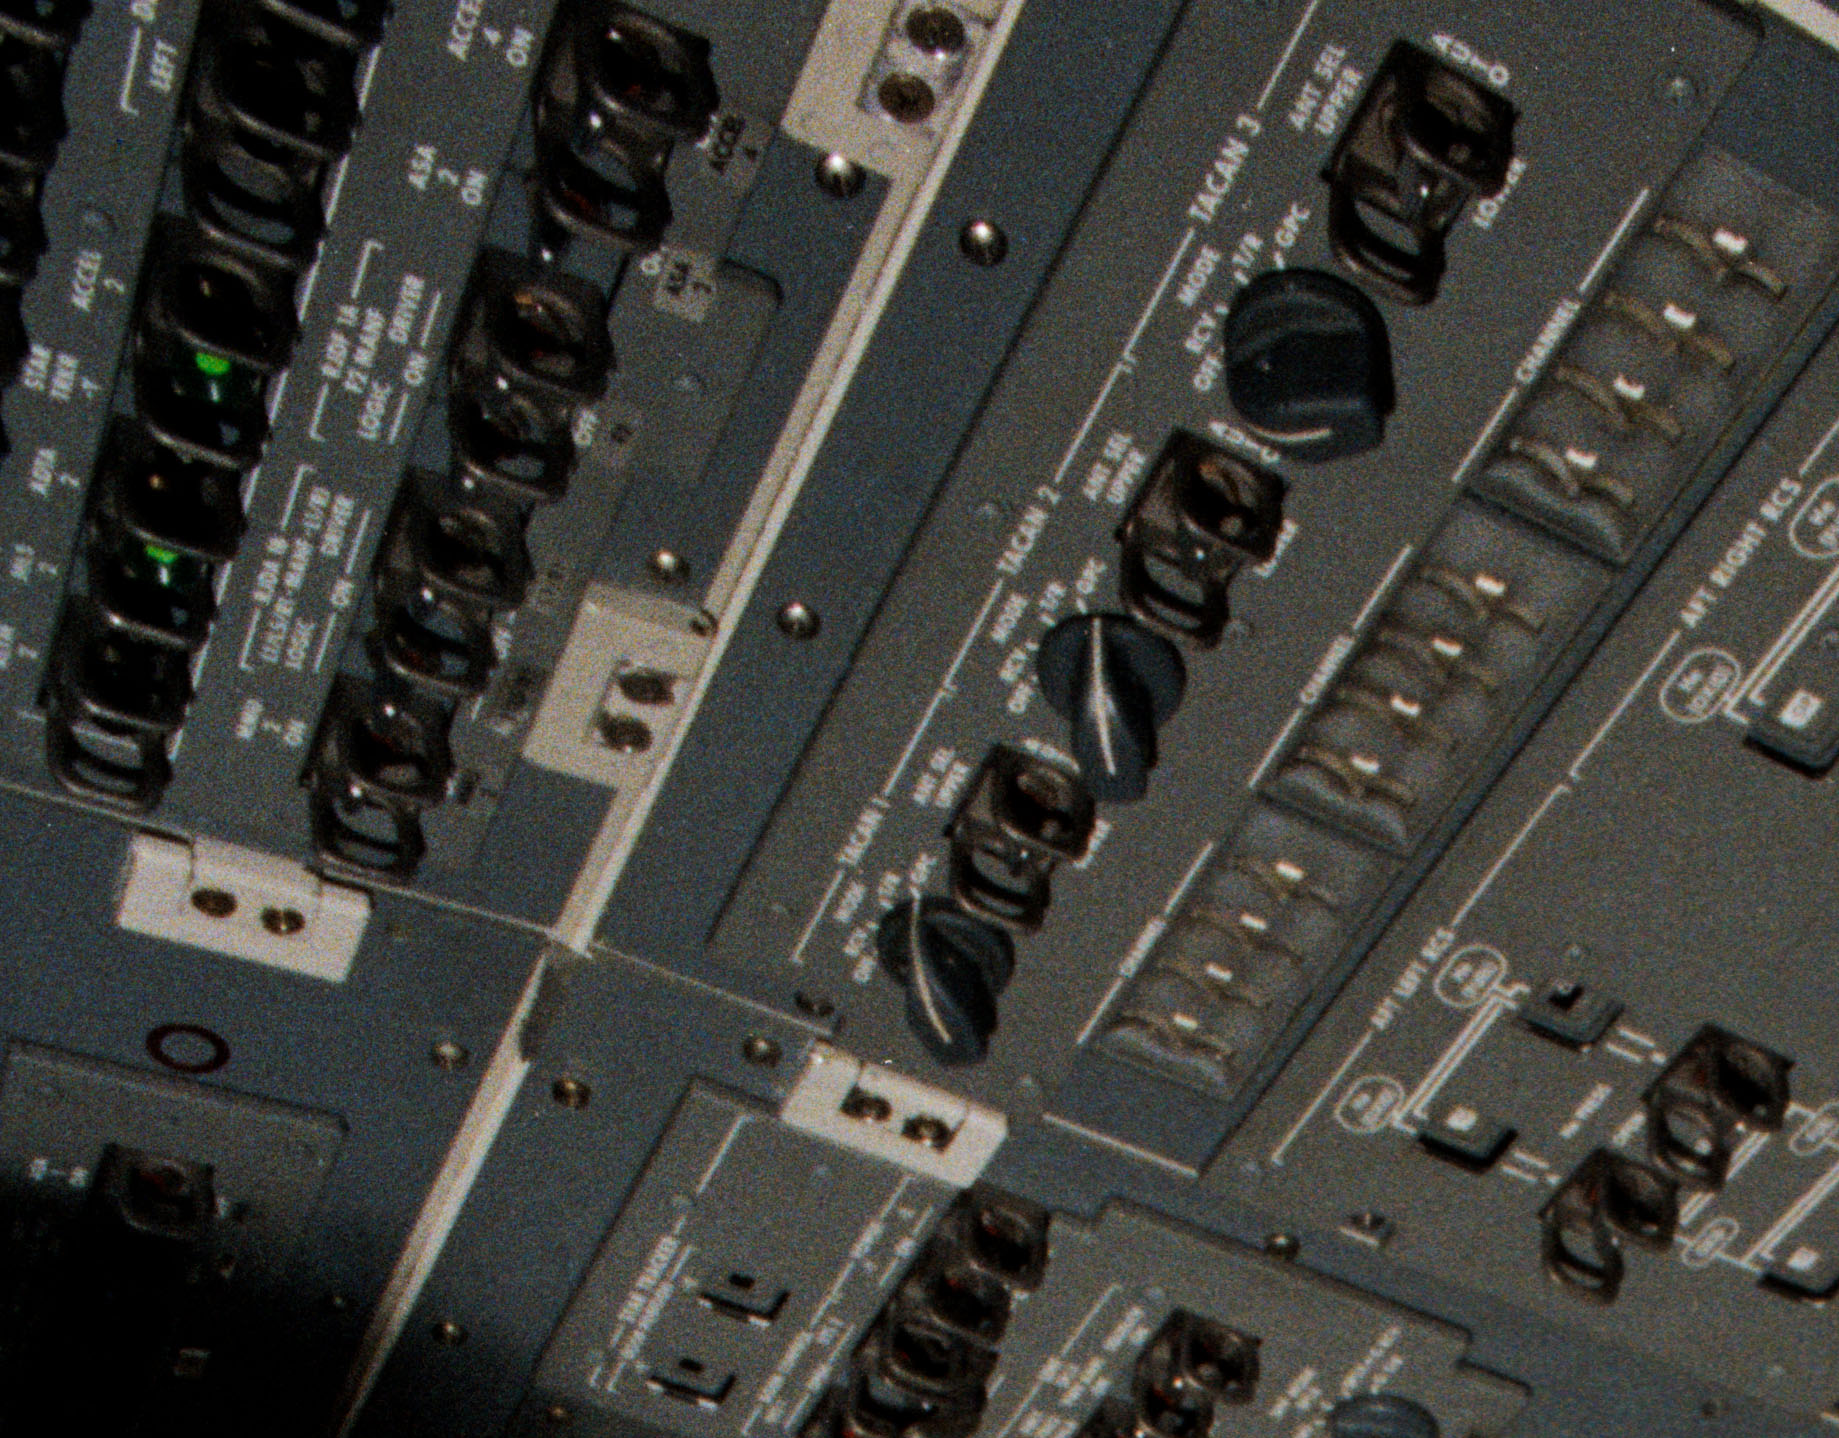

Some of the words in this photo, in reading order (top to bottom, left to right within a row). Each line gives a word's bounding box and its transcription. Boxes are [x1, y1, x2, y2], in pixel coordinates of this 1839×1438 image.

[447, 0, 483, 60] ACCE
[483, 28, 502, 45] 4
[505, 27, 534, 68] ON
[1432, 33, 1510, 87] AUTO
[1289, 84, 1321, 131] ANT
[1313, 44, 1346, 81] SEL
[1314, 67, 1362, 135] UPPER
[408, 145, 436, 190] ASA
[436, 168, 459, 186] 2
[460, 169, 487, 206] ON
[1189, 138, 1249, 221] TACAN
[1236, 115, 1261, 135] 3
[1275, 204, 1309, 248] GPC
[70, 250, 102, 311] ACCEL
[1178, 247, 1220, 305] MODE
[387, 274, 425, 345] DRIVER
[1184, 313, 1216, 354] RCV
[353, 308, 384, 367] MANF
[1514, 299, 1581, 384] CHANNEL
[403, 353, 427, 386] ON
[1193, 355, 1220, 391] OFF
[358, 381, 392, 440] LOGIC
[1084, 463, 1110, 500] ANT
[1104, 434, 1131, 460] SEL
[1108, 450, 1145, 504] UPPER
[997, 508, 1047, 573] TACAN
[1037, 486, 1060, 504] 2
[1681, 588, 1714, 628] AFT
[1710, 522, 1765, 587] RIGHT
[1760, 478, 1802, 521] RCS
[330, 579, 353, 607] ON
[1076, 559, 1105, 595] GPC
[992, 594, 1027, 642] MODE
[1298, 634, 1355, 705] CHANNEL
[839, 810, 882, 864] TACAN
